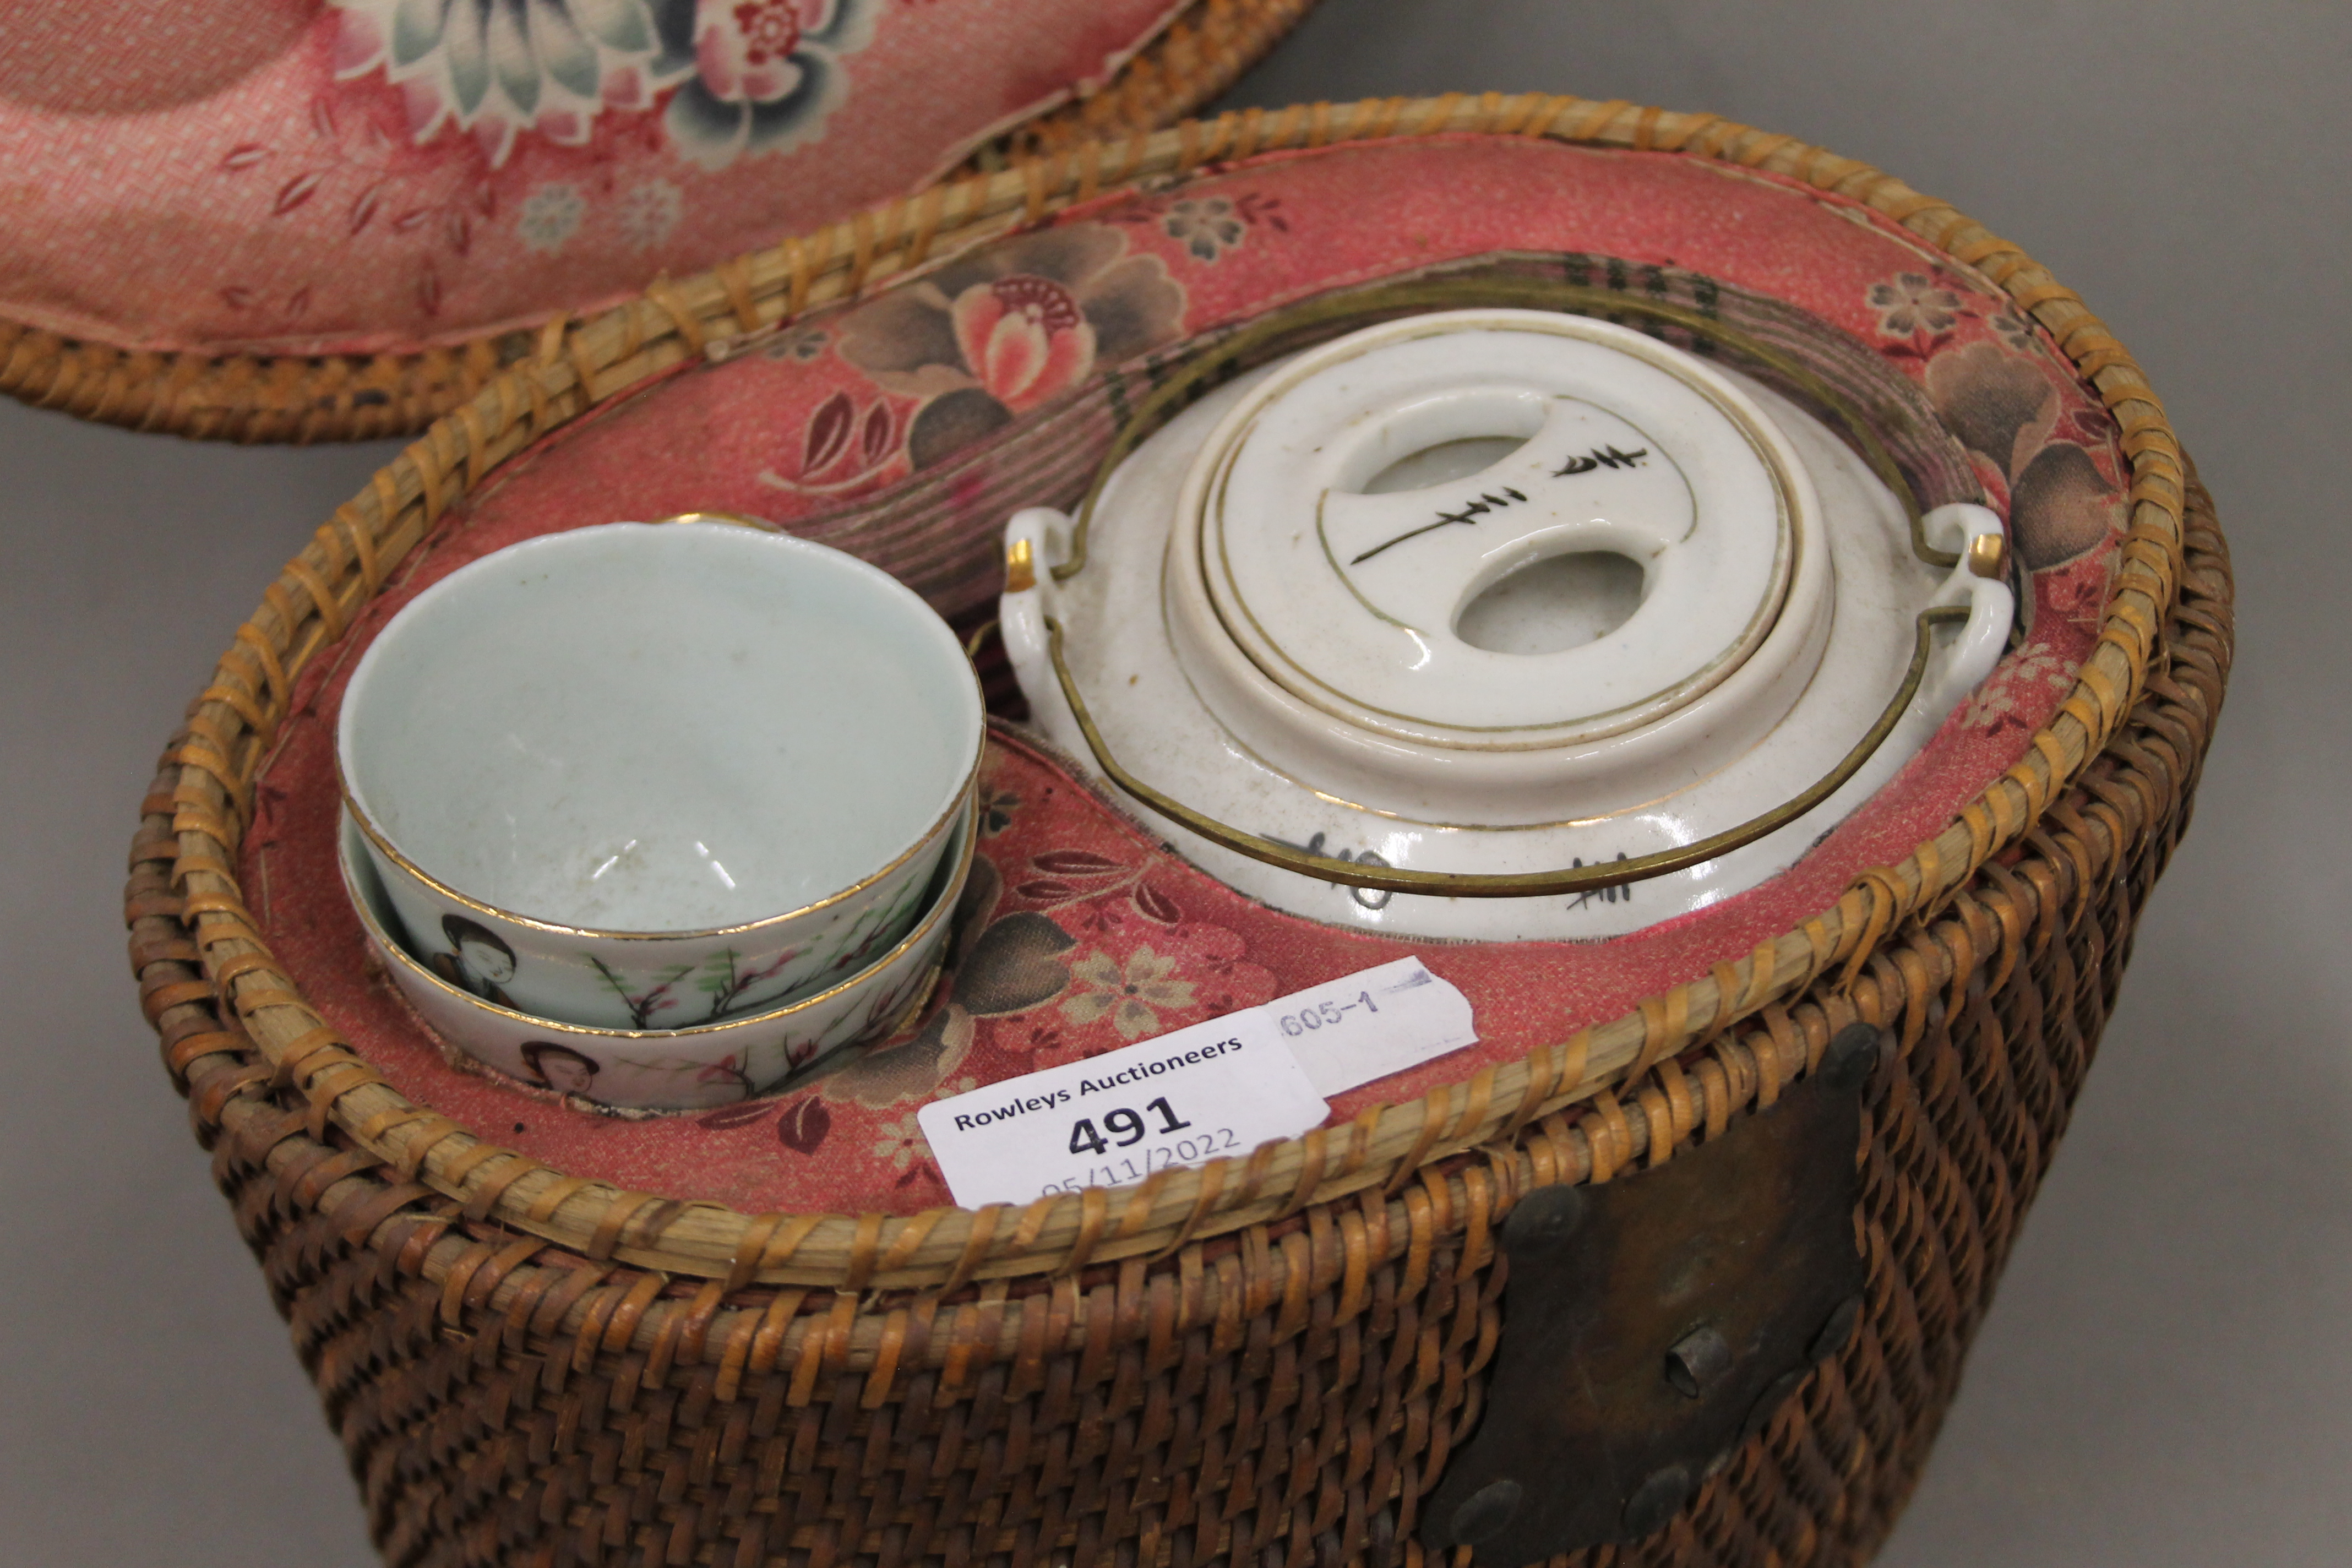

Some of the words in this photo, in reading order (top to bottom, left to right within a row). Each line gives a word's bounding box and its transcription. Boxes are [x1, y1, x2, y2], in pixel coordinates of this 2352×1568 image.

[954, 1087, 1071, 1131] Rowleys
[1080, 1036, 1243, 1096] Auctioneers
[1069, 1096, 1191, 1156] 491
